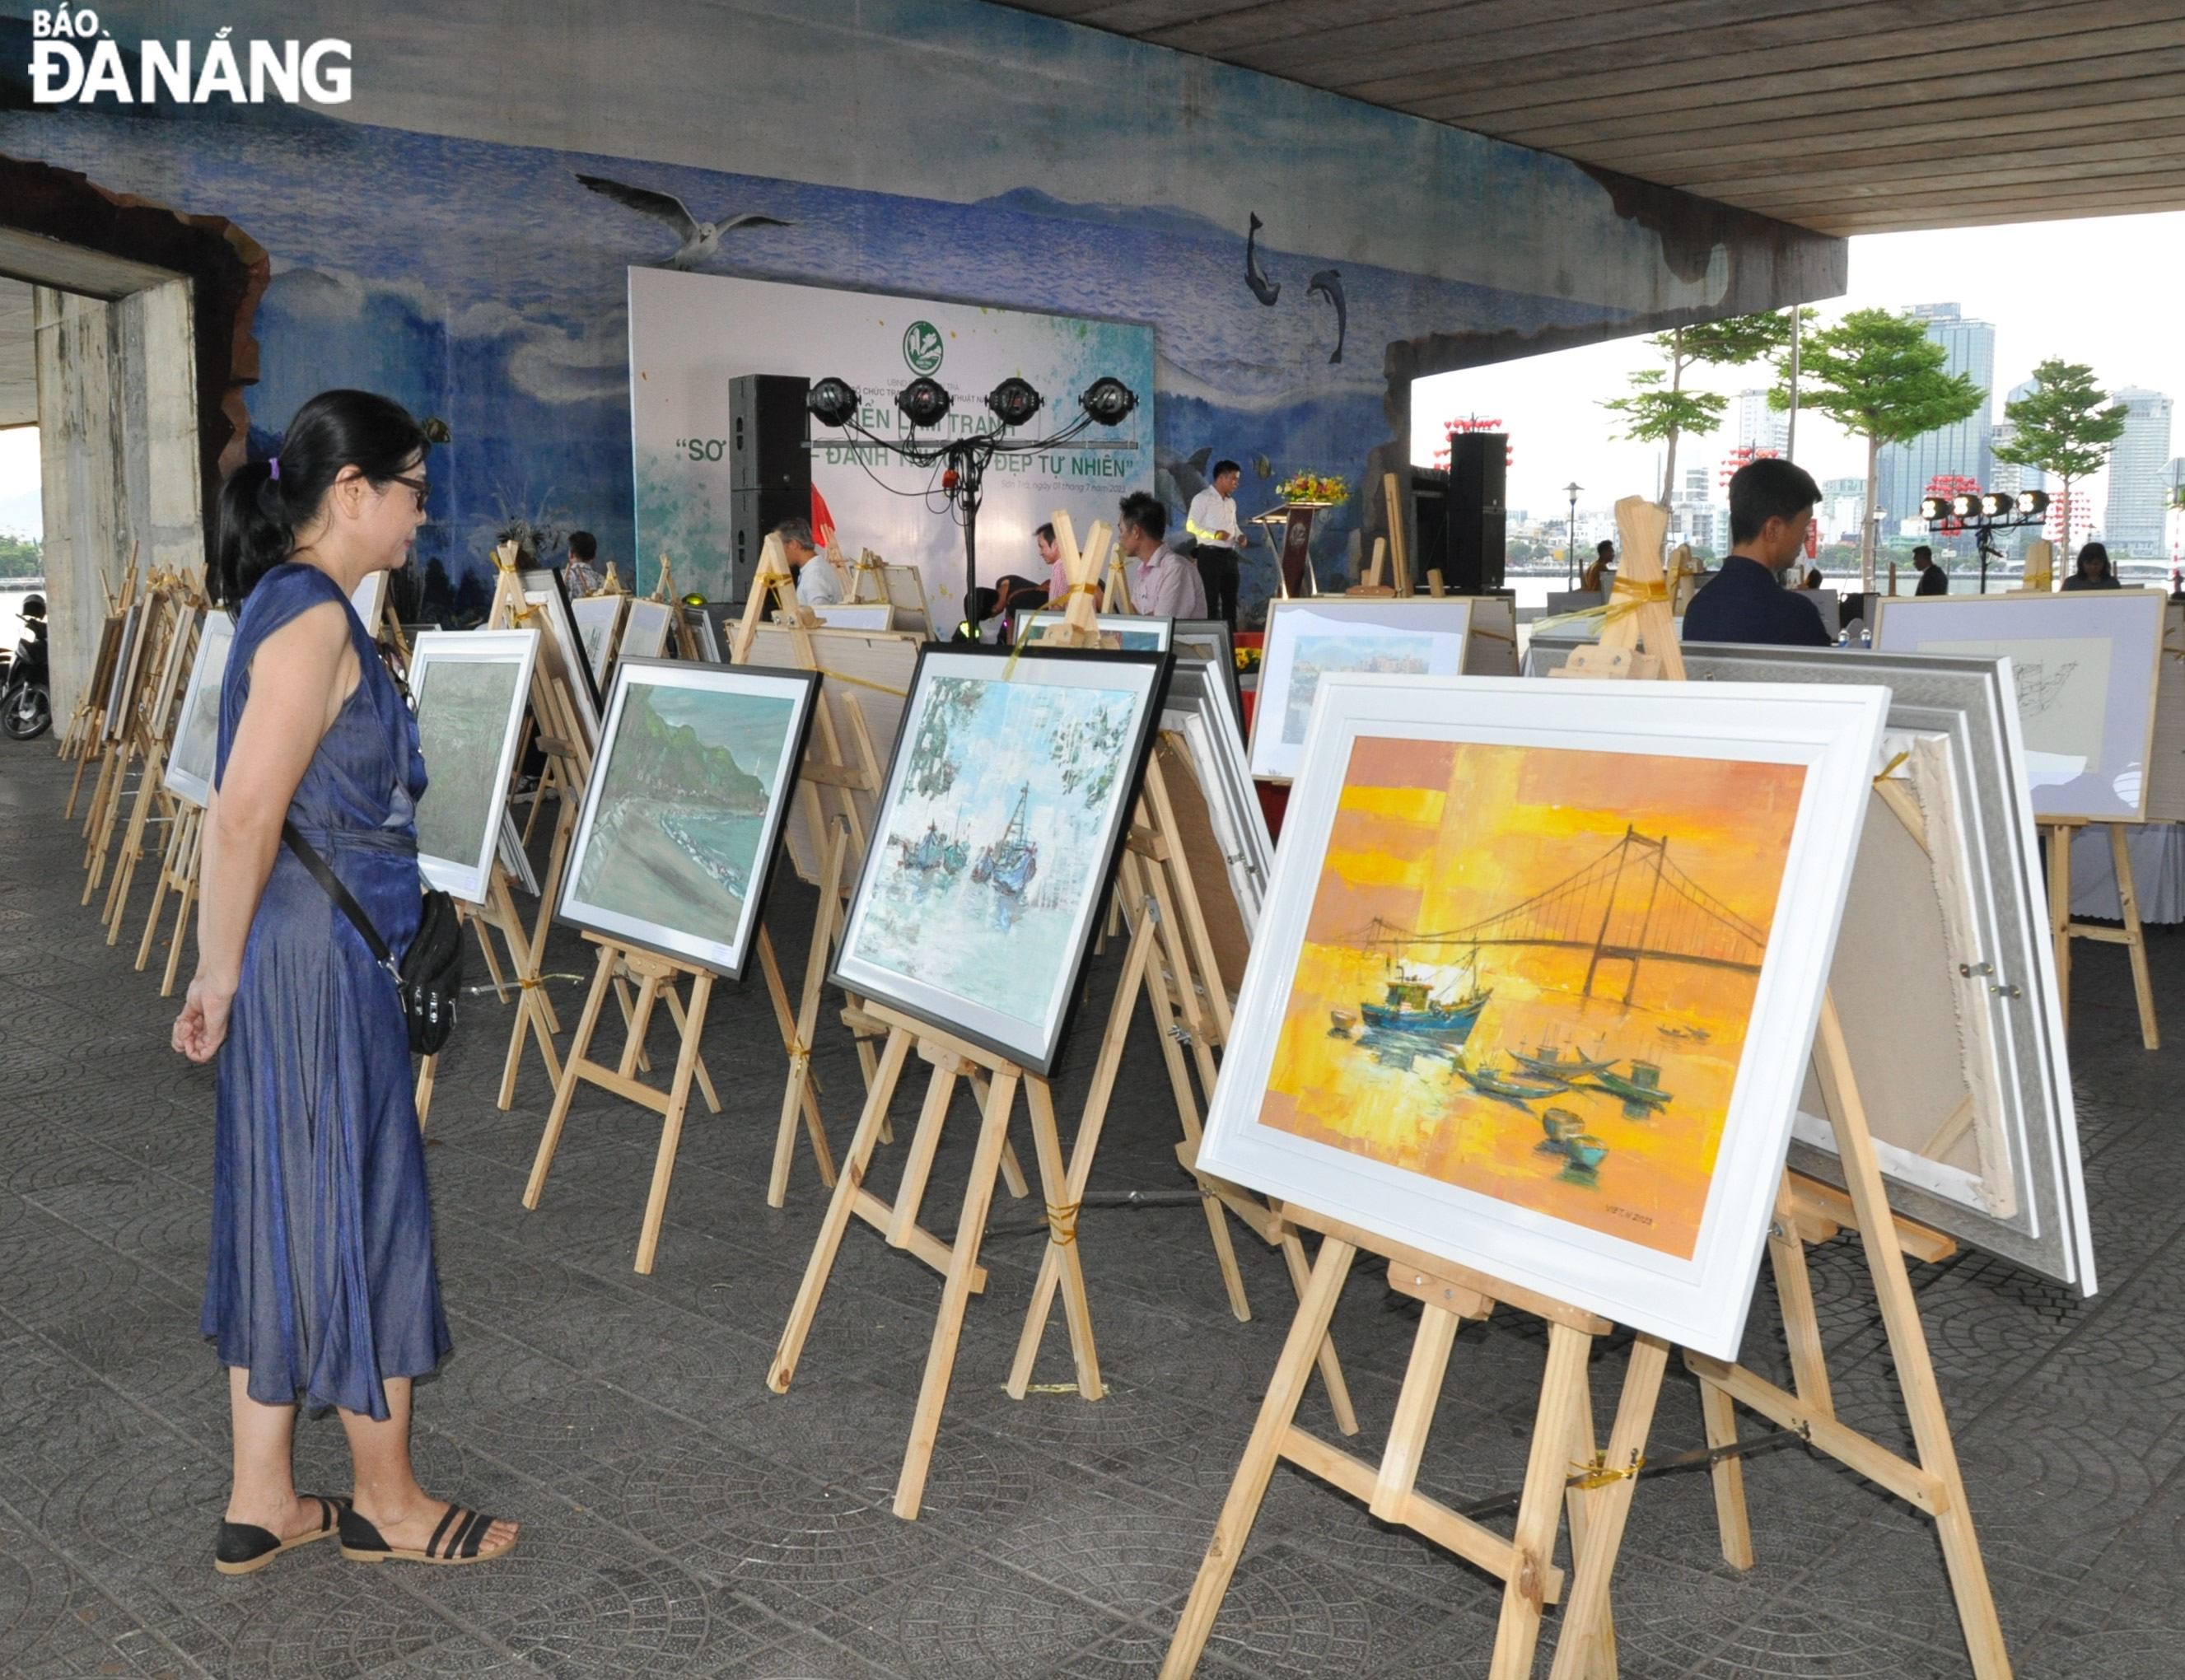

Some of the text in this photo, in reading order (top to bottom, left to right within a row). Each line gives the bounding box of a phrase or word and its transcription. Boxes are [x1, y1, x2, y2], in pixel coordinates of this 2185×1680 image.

[994, 453, 1032, 477] ĐẸP
[1038, 455, 1065, 479] TỰ
[1033, 483, 1051, 492] ngày
